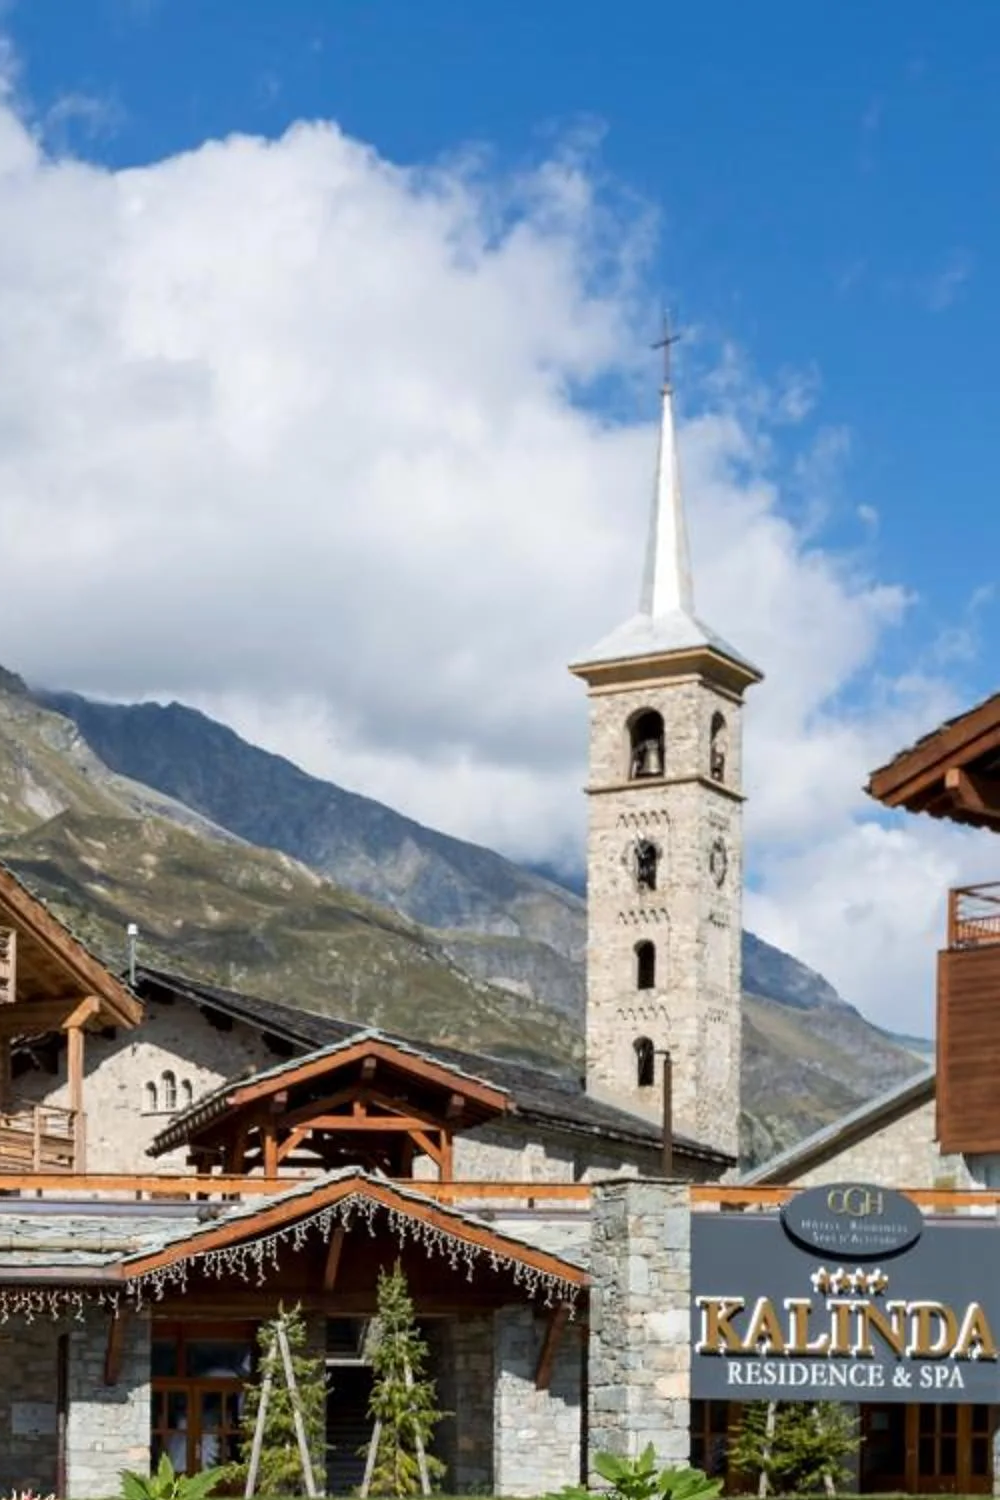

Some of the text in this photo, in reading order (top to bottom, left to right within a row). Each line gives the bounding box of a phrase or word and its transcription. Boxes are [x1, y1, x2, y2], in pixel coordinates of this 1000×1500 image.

[827, 1188, 884, 1216] CGH
[695, 1296, 998, 1361] KALINDA
[727, 1362, 965, 1388] RESIDENCE & SPA
